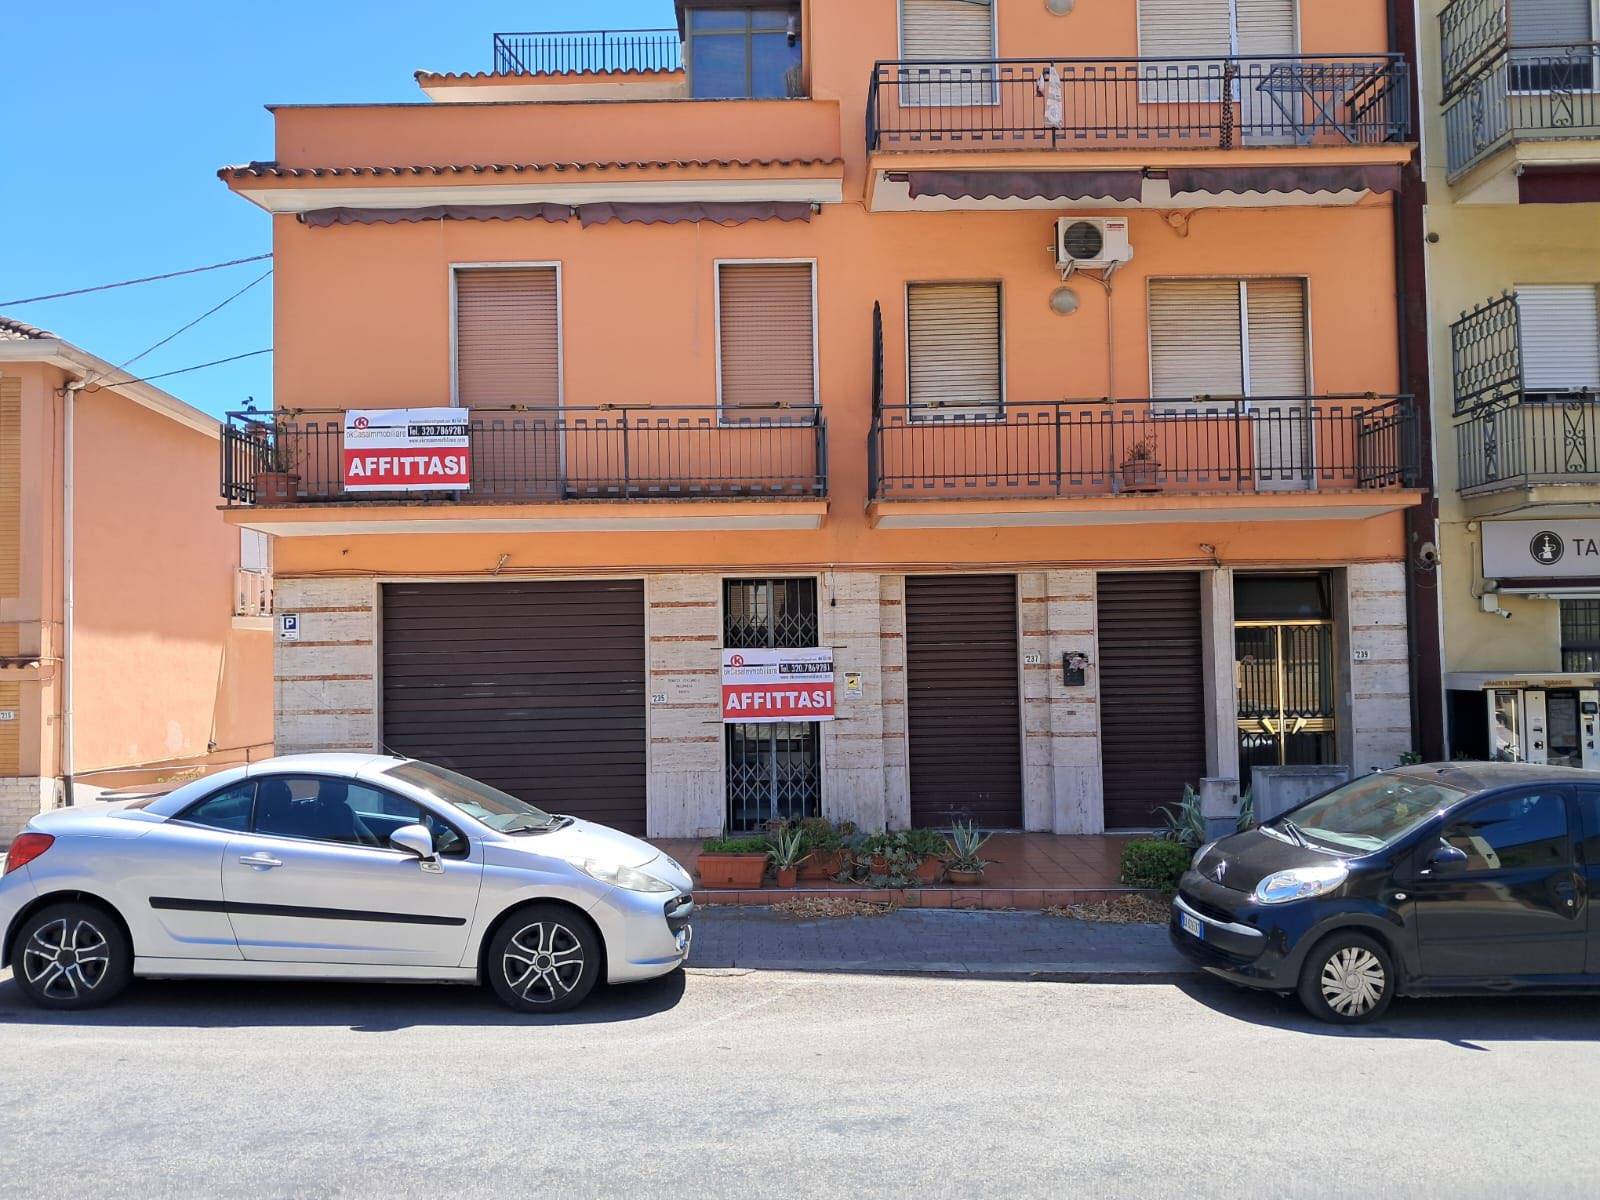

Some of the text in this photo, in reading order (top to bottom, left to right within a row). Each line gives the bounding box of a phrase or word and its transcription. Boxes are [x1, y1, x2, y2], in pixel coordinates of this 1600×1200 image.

[409, 425, 466, 436] Tel. 320.7869281
[348, 455, 467, 476] AFFITTASI
[1025, 655, 1039, 663] 237
[1355, 650, 1368, 658] 239
[652, 694, 665, 703] 235
[726, 690, 832, 710] AFFITTASI
